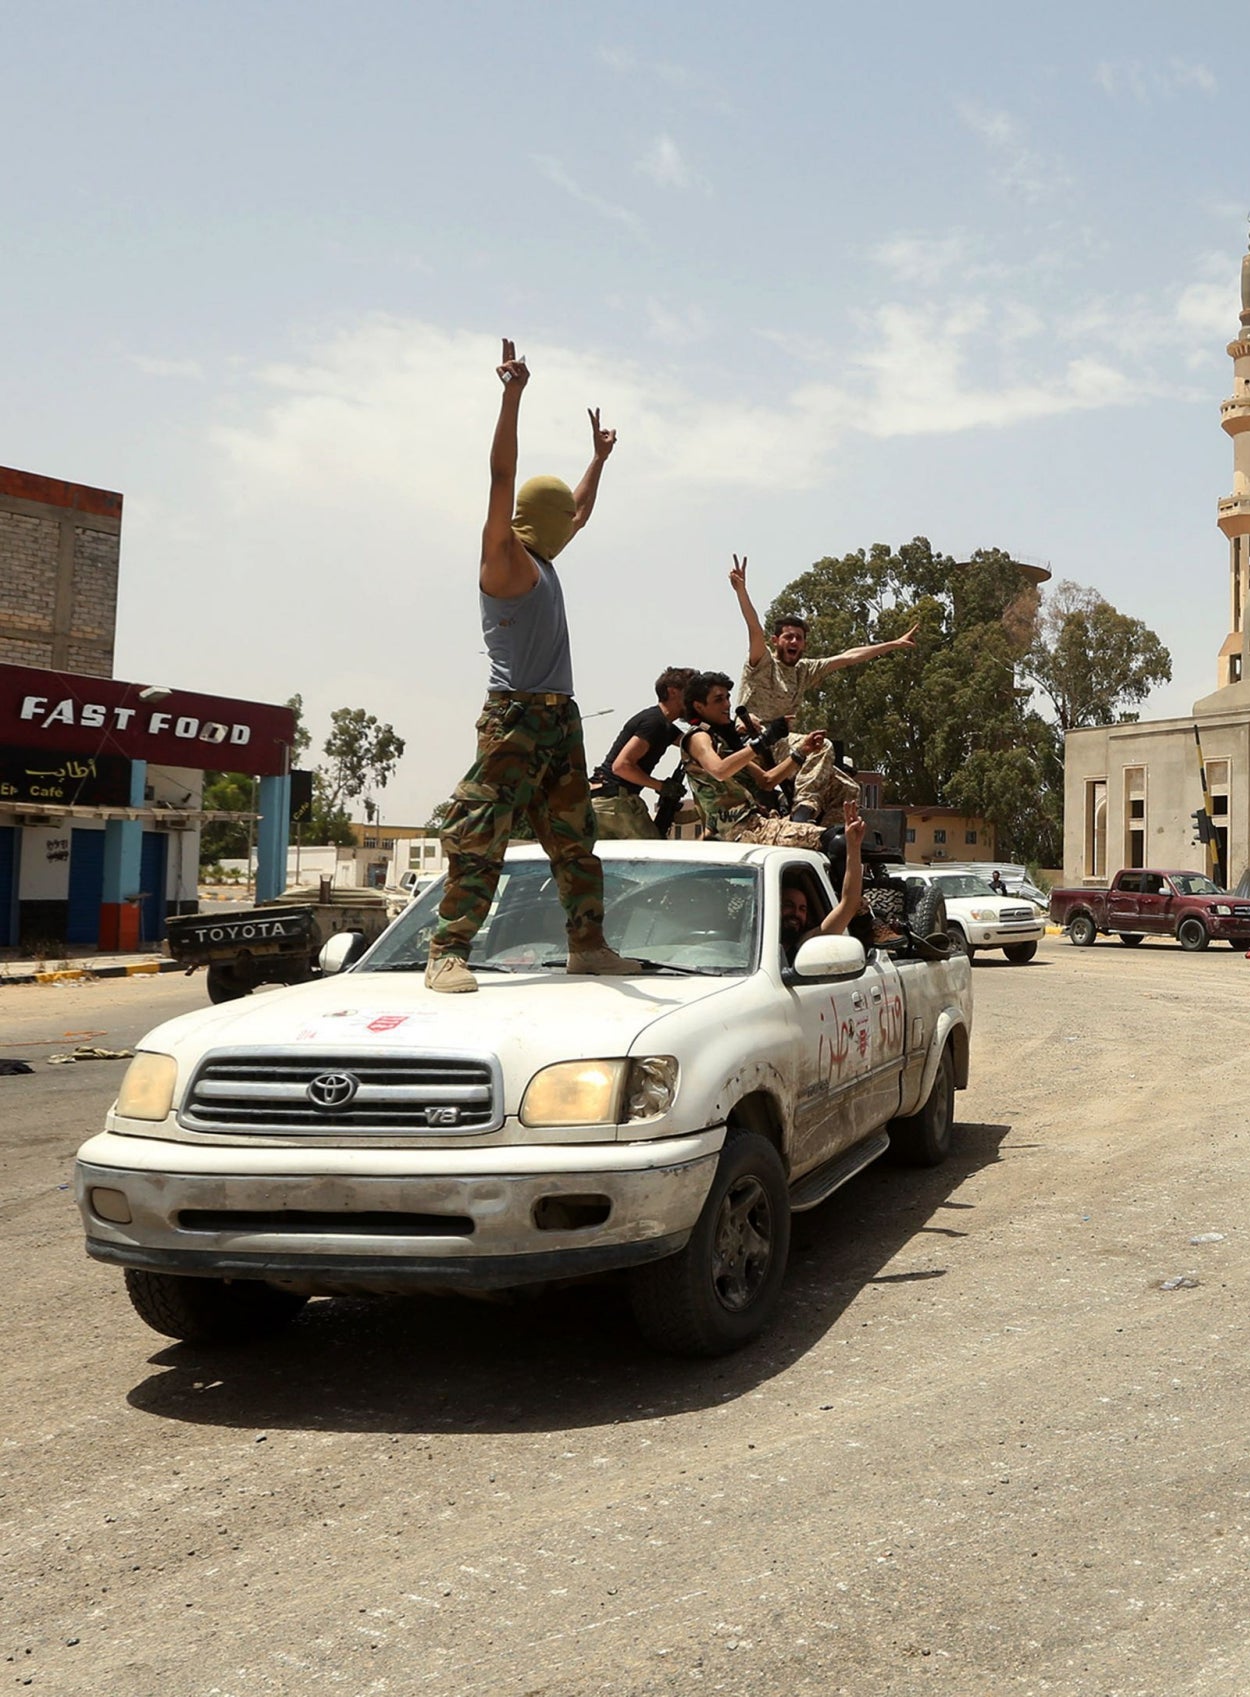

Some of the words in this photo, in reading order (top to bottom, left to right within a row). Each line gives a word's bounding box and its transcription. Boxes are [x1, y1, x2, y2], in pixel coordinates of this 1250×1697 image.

[20, 696, 136, 730] FAST
[148, 712, 251, 746] FOOD
[30, 785, 64, 798] Café
[195, 922, 286, 943] TOYOTA
[425, 1106, 461, 1126] V8
